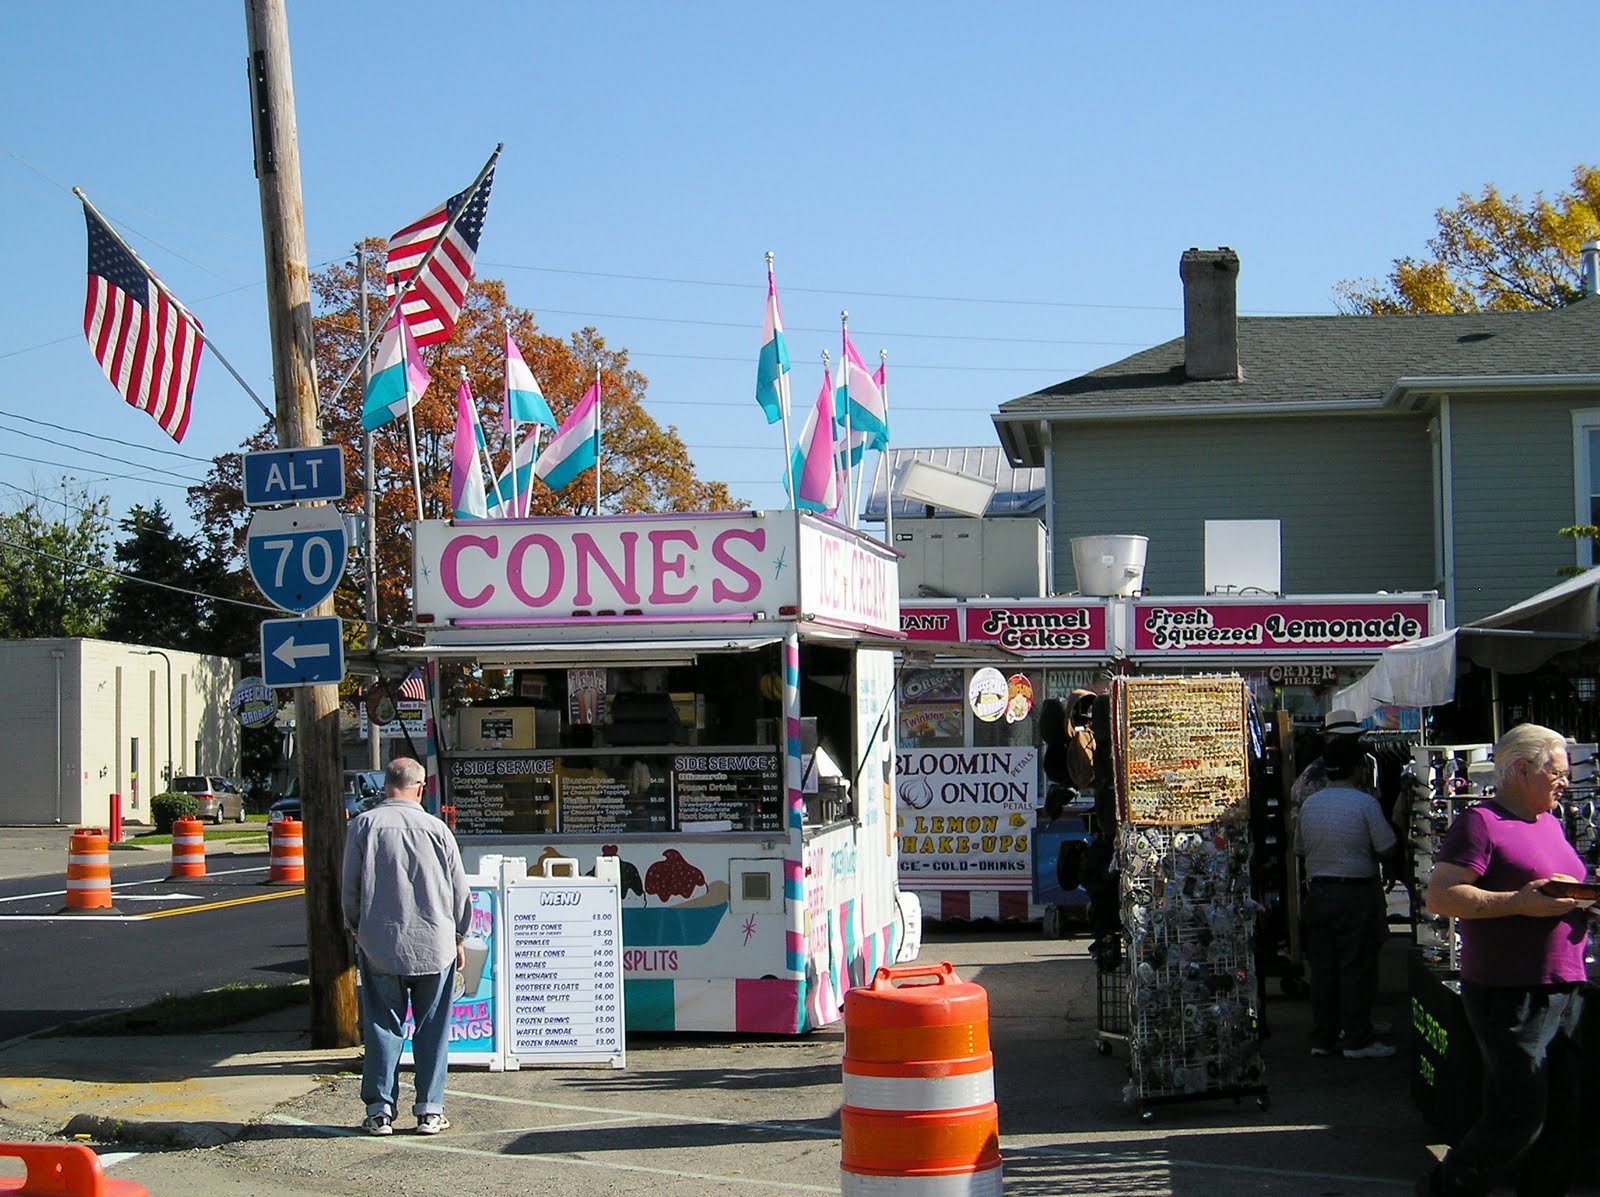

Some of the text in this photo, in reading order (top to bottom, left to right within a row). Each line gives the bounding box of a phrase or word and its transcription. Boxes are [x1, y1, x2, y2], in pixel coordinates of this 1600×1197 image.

[265, 459, 322, 492] ALT
[263, 535, 333, 588] 70
[440, 528, 767, 609] CONES
[819, 535, 887, 623] ICE CREAM
[899, 615, 949, 630] IANT
[983, 608, 1090, 634] Funnel
[1145, 608, 1422, 643] Fresh Lemonade
[1000, 628, 1090, 650] Cakes
[1153, 624, 1262, 649] Squeezed
[1048, 670, 1095, 688] ONION
[1269, 665, 1337, 686] ORDER HERE
[463, 759, 555, 776] SIDE SERVICE
[675, 756, 768, 771] SIDE SERVICE
[1010, 751, 1035, 778] PETALS
[708, 783, 738, 792] Drinks
[941, 782, 1030, 804] ONION
[1003, 802, 1033, 811] PETALS
[914, 815, 998, 834] LEMON
[898, 835, 1028, 855] HAKE-UPS
[899, 860, 1026, 872] CE-COLD-DRINKS
[540, 891, 582, 907] MENU
[513, 913, 613, 922] CONES $3.00
[513, 924, 540, 932] DIPPED
[514, 950, 542, 958] WAFFLE
[623, 950, 679, 972] SPLITS
[515, 961, 547, 969] SUNDAES
[515, 971, 614, 980] MILKSHAKES $4.00
[515, 983, 552, 991] ROOTBEER
[594, 982, 615, 990] $4.00
[515, 994, 545, 1002] BANANA
[594, 993, 615, 1001] $6.00
[516, 1017, 542, 1025] FROZEN
[516, 1028, 542, 1036] WAFFLE
[595, 1027, 615, 1035] $5.00
[516, 1039, 543, 1047] FROZEN
[595, 1038, 616, 1046] $3.00
